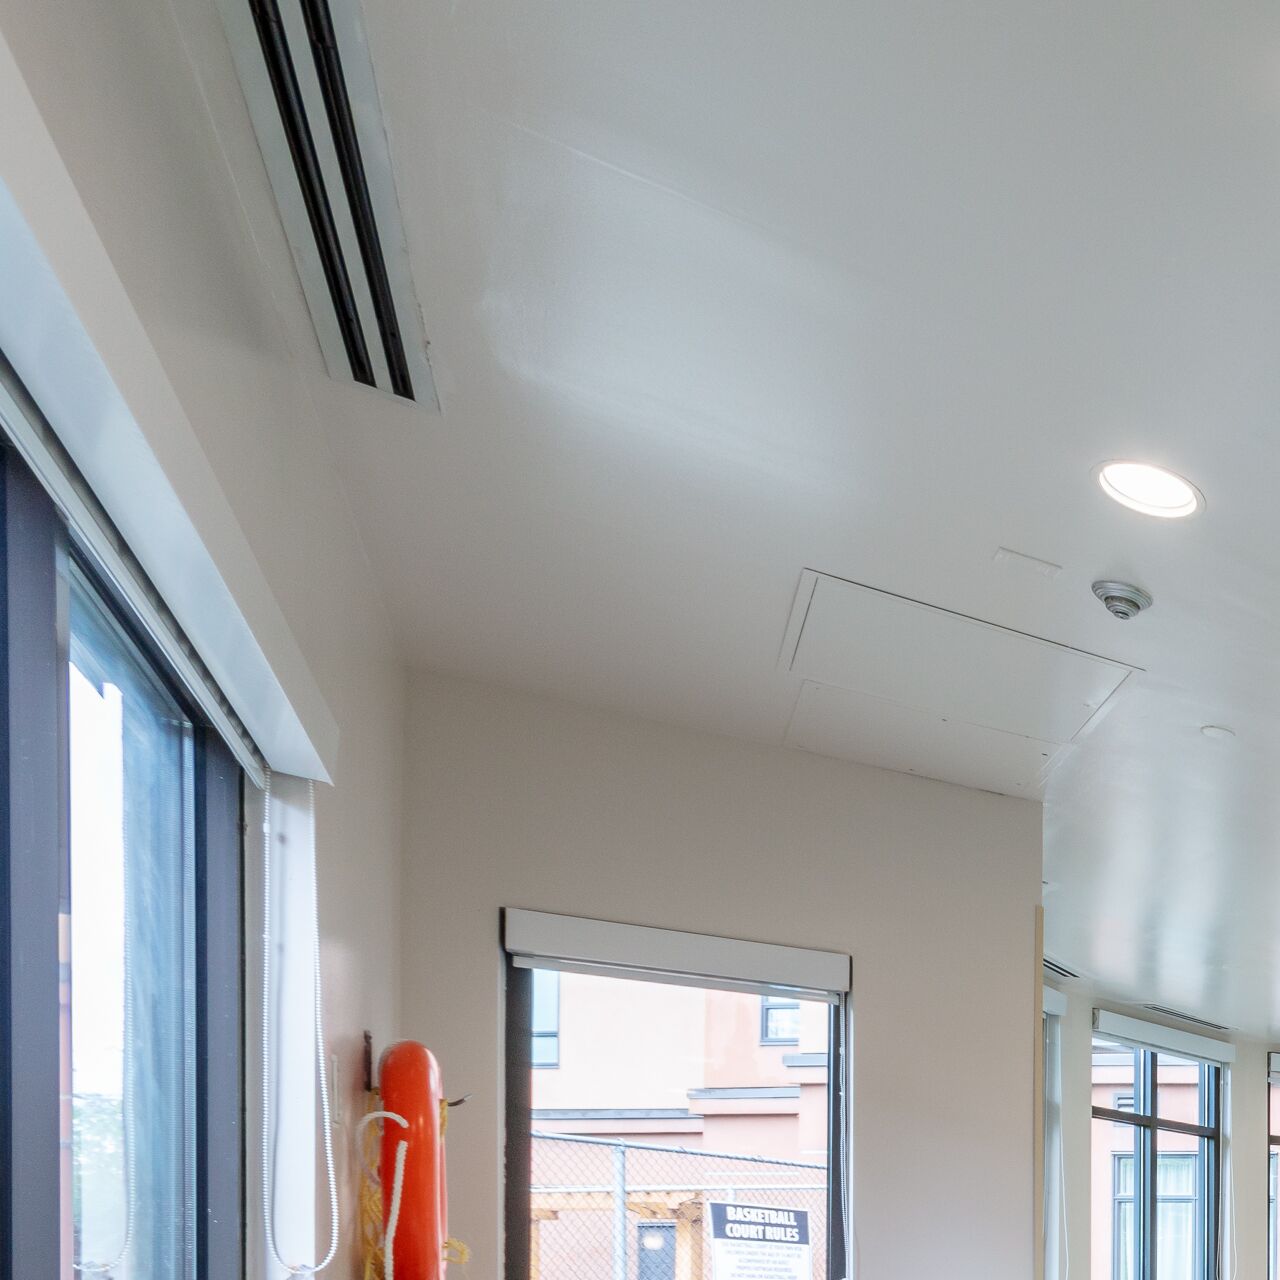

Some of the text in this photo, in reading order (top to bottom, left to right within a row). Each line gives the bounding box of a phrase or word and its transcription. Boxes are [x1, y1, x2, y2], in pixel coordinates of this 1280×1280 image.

[726, 1206, 797, 1226] BASKETBALL
[725, 1223, 800, 1241] COURT RULES
